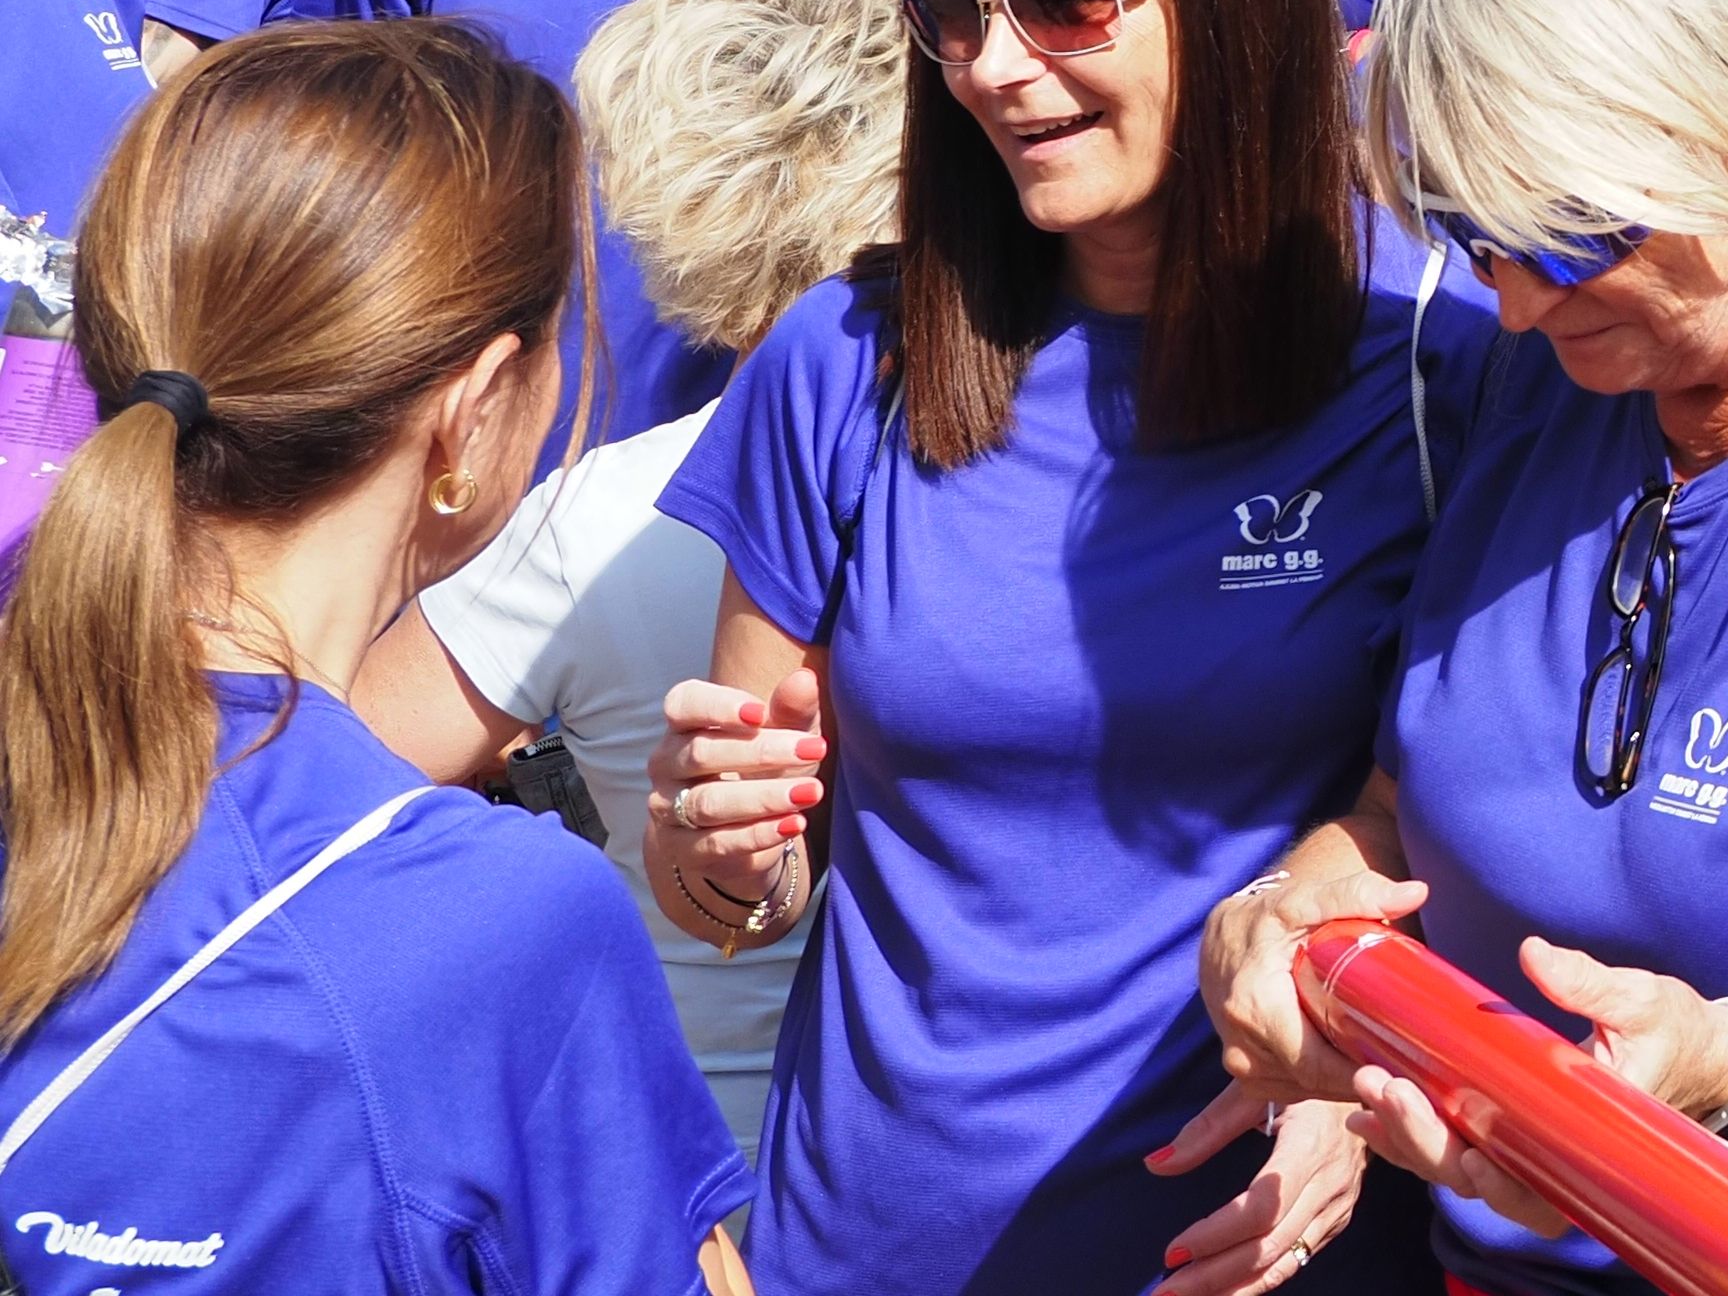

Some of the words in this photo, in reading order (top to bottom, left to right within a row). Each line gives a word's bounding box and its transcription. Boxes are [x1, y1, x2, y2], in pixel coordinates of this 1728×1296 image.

[1222, 553, 1277, 571] marc
[1284, 550, 1324, 571] g.g.
[1659, 773, 1699, 797] marc
[16, 1211, 225, 1268] Viladomat
